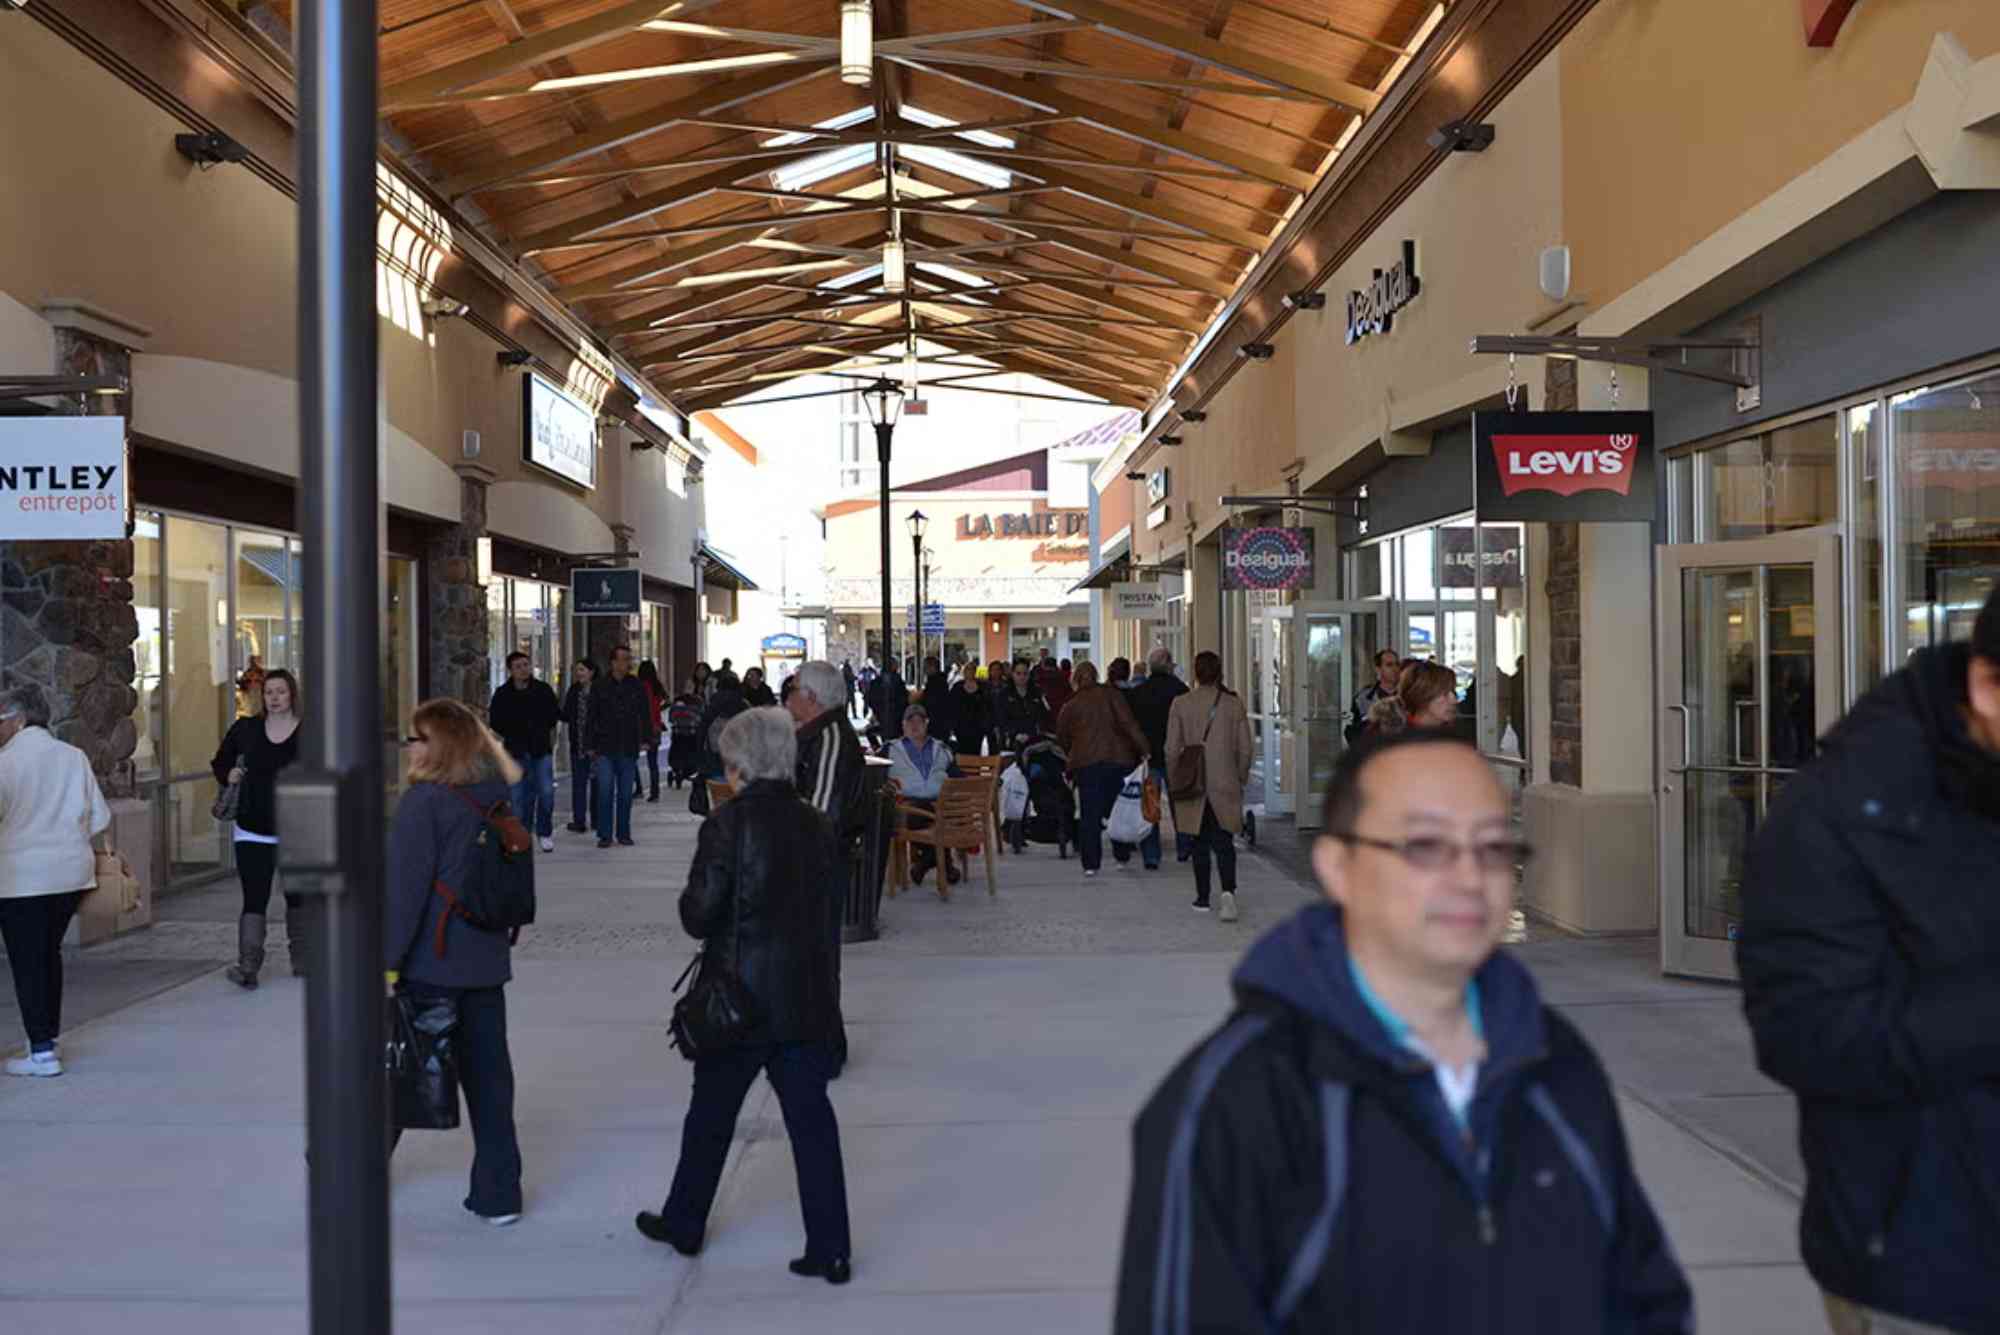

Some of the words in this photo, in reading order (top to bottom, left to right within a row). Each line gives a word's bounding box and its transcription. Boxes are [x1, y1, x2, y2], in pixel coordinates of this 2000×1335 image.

[19, 492, 117, 515] entrepôt
[963, 513, 993, 536] LA
[1002, 513, 1058, 536] BAIE
